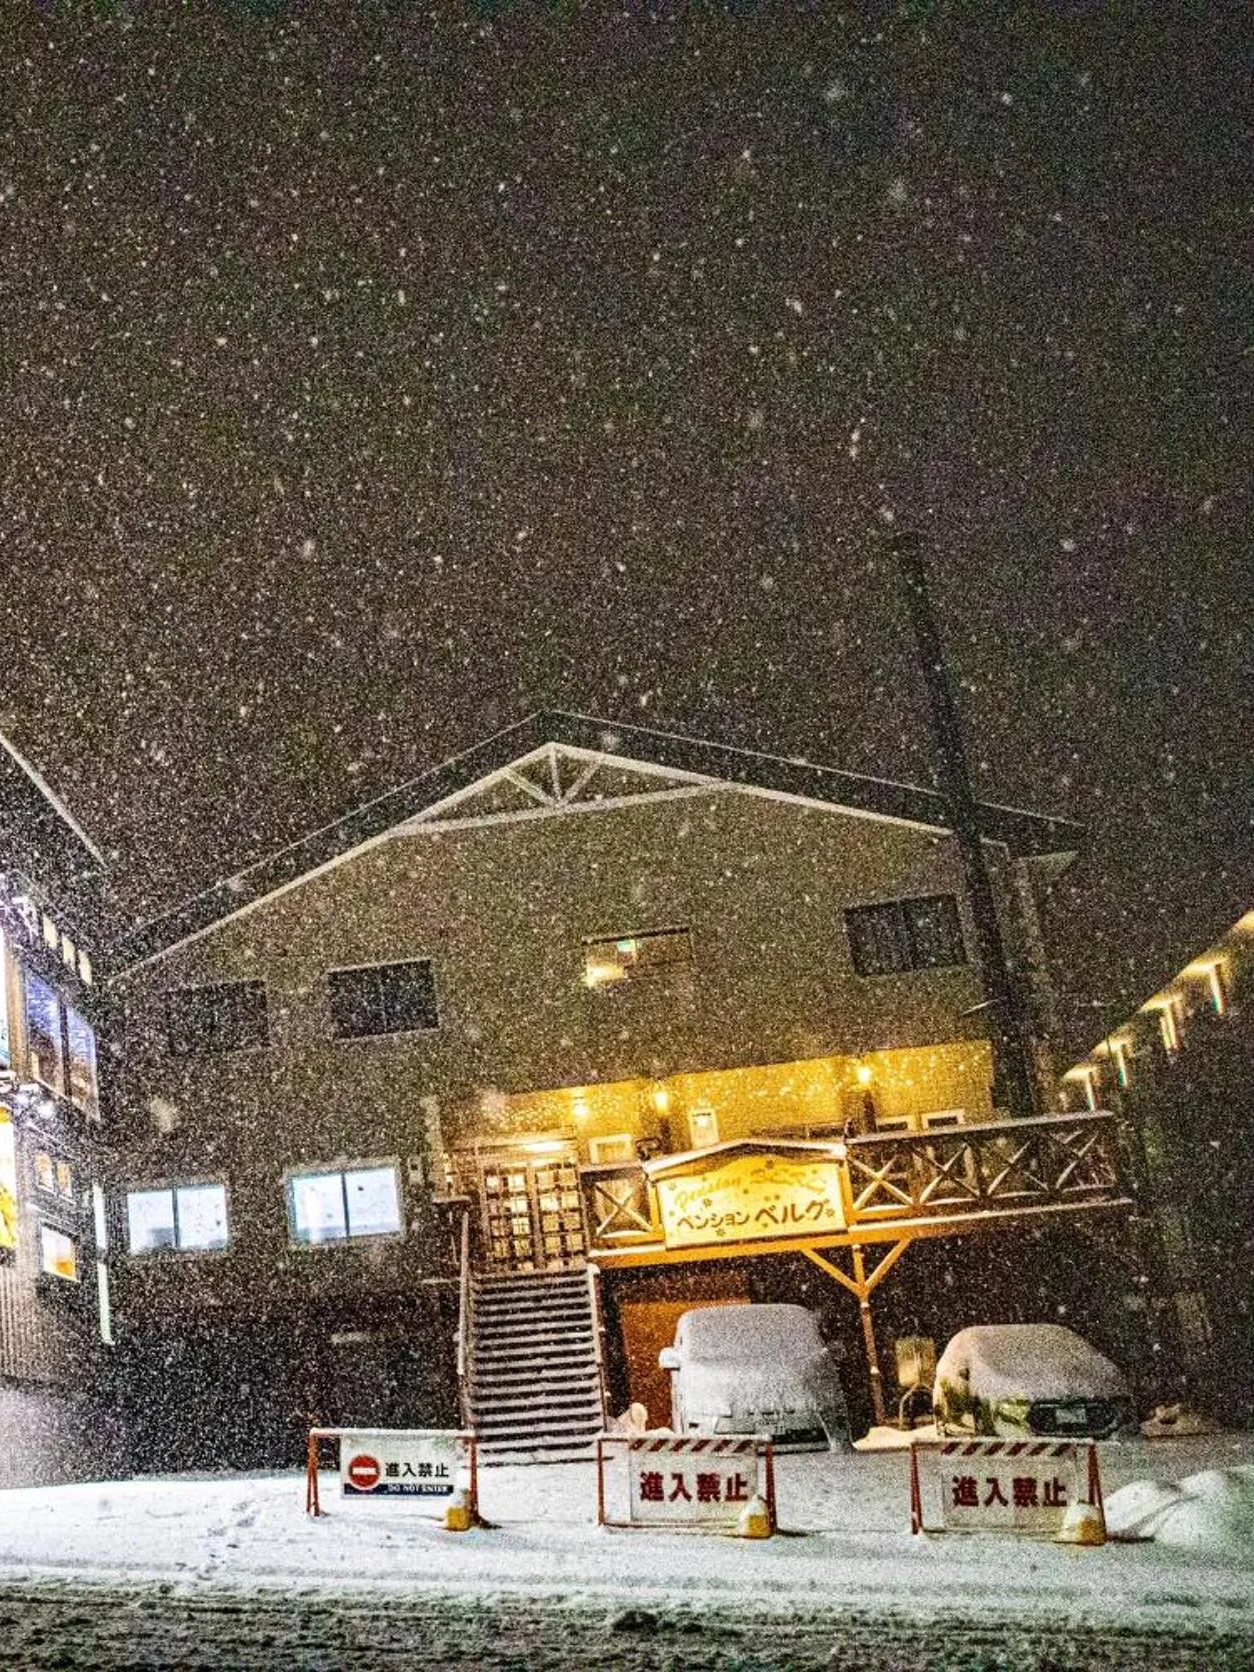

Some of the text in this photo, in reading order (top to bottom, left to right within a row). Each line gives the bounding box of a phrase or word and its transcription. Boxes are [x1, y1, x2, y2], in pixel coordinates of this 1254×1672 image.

[386, 1462, 449, 1477] 進入禁止
[640, 1471, 749, 1502] 進入禁止
[952, 1475, 1068, 1507] 進入禁止
